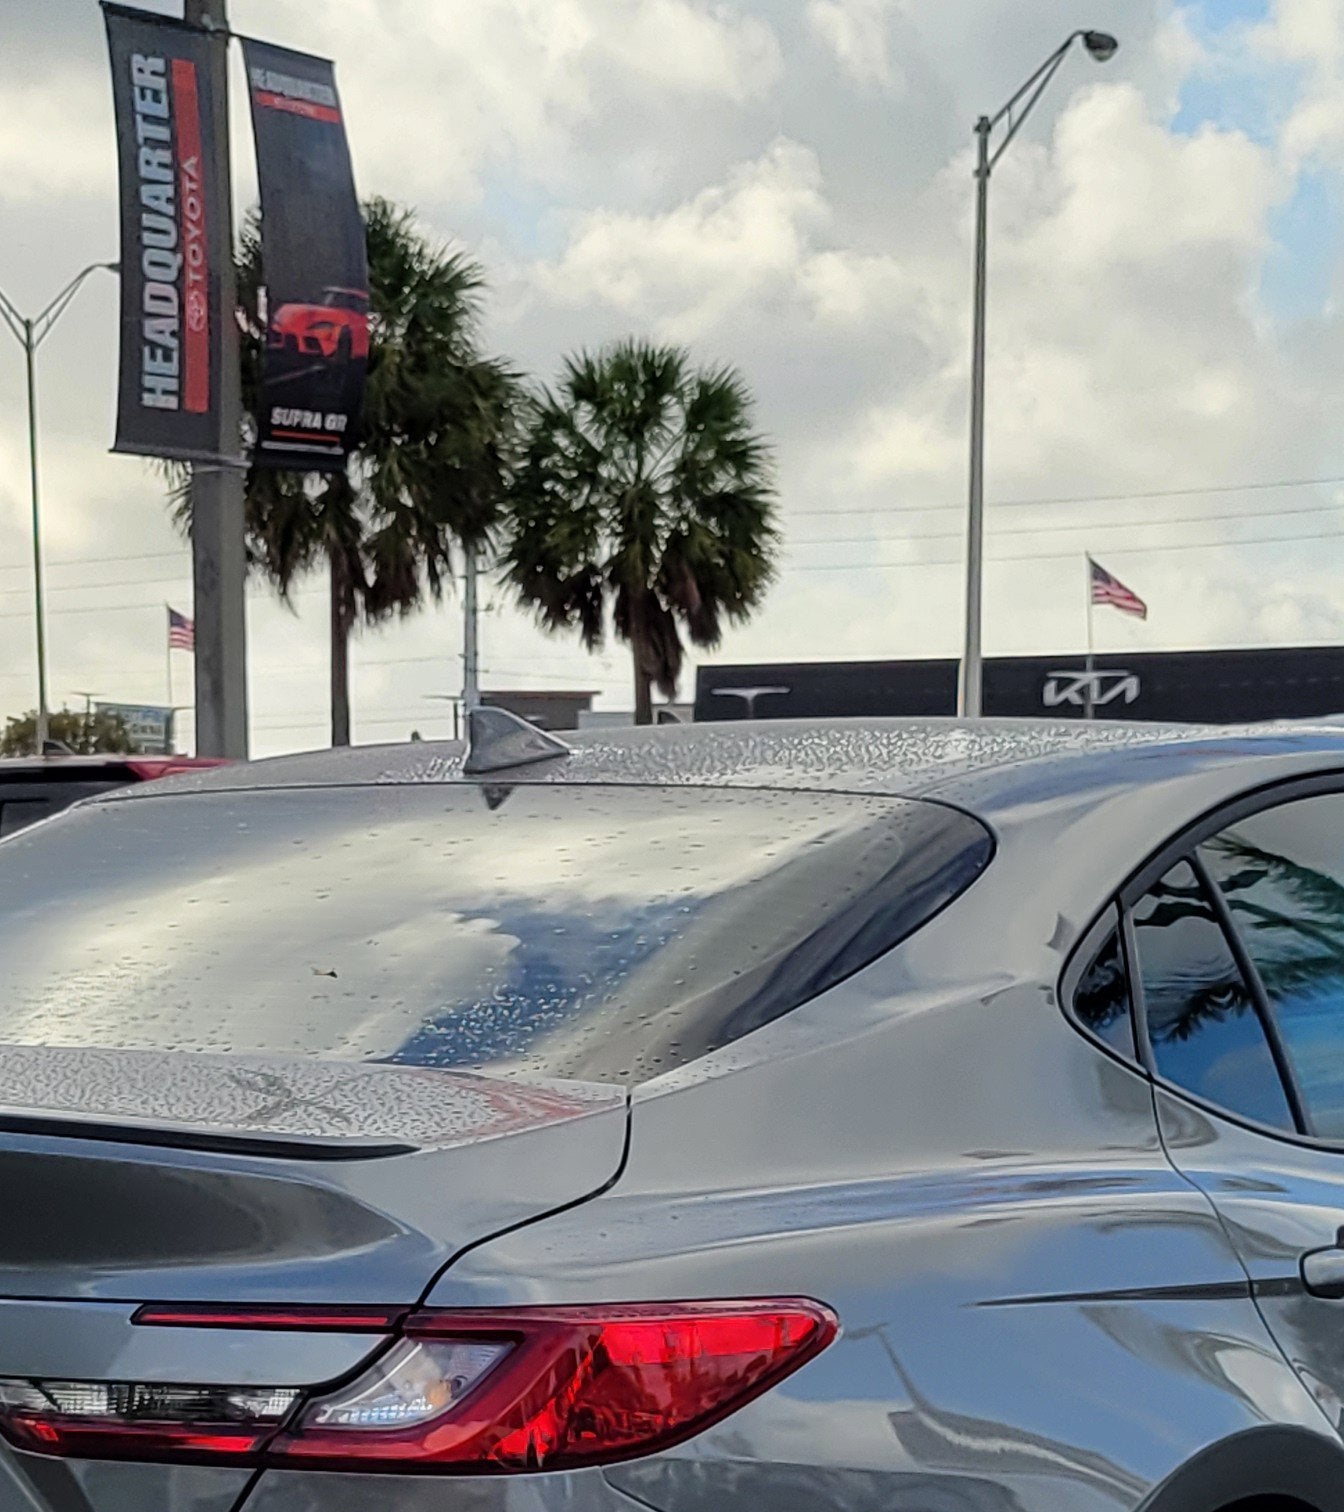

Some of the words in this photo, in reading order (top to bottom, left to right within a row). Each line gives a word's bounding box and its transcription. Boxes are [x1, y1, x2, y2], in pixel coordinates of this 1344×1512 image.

[130, 53, 184, 411] HEADQUARTER
[180, 156, 206, 297] TOYOTA
[271, 406, 322, 429] SUPRA
[1043, 669, 1140, 707] KIA
